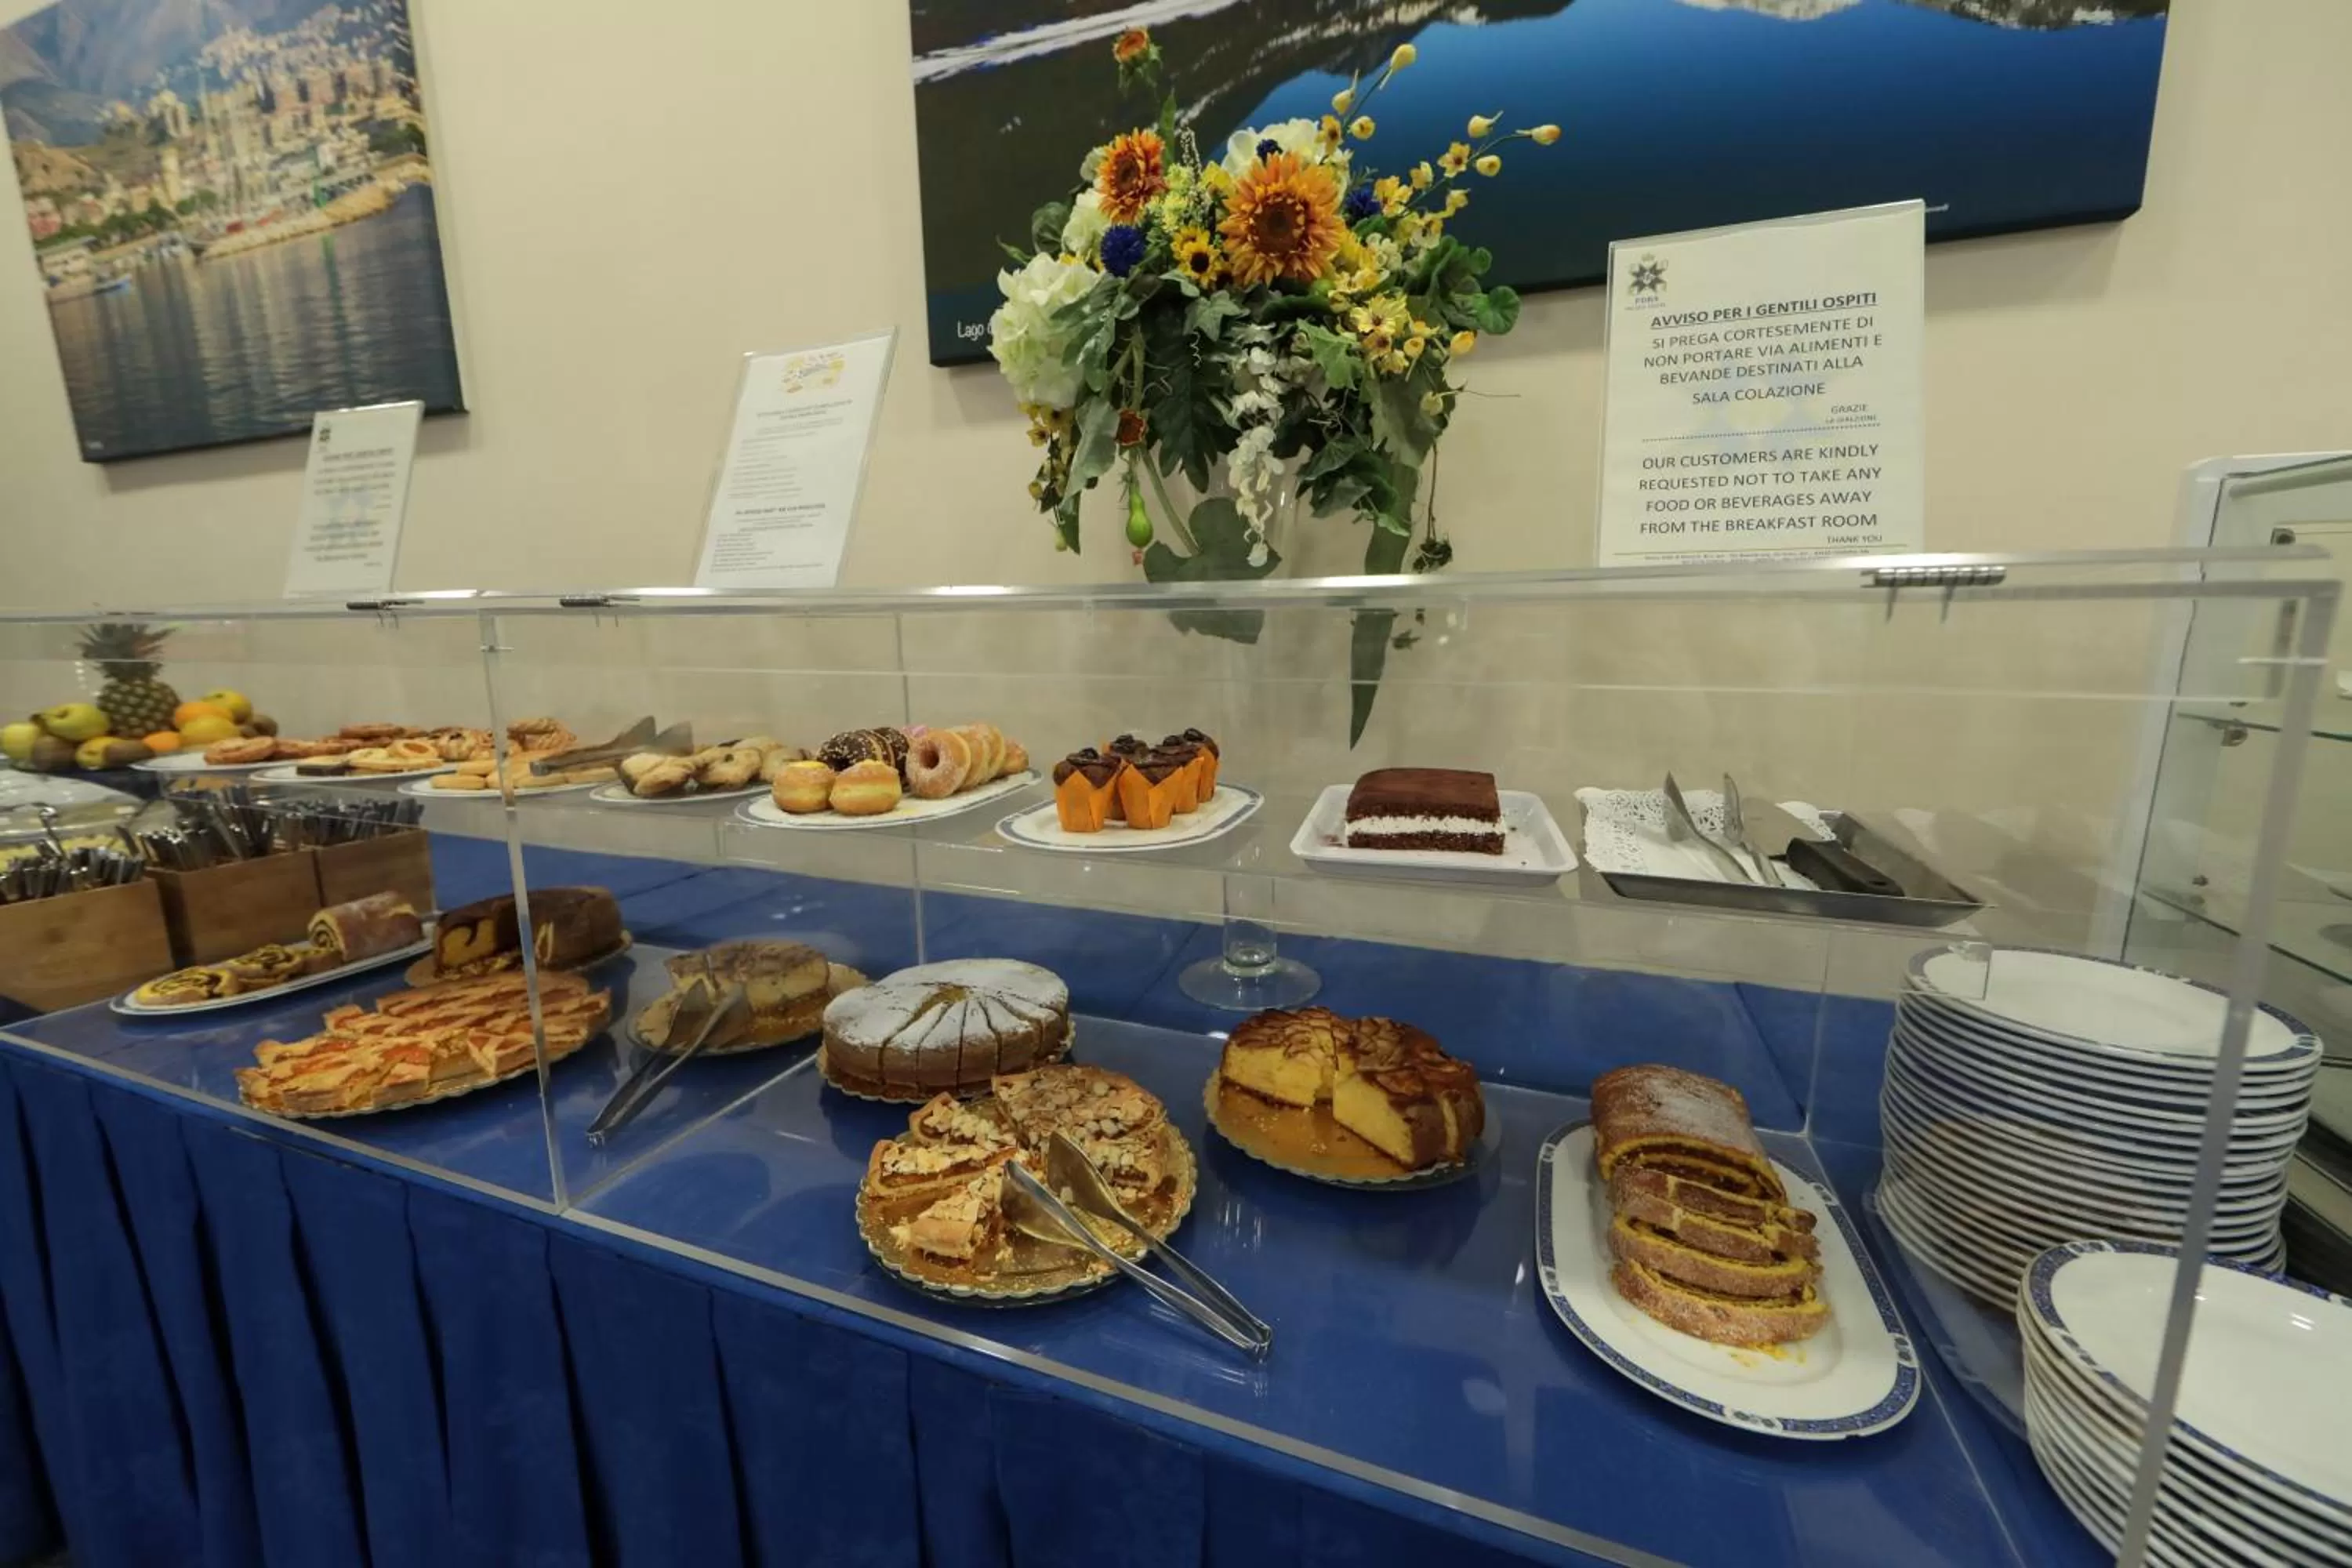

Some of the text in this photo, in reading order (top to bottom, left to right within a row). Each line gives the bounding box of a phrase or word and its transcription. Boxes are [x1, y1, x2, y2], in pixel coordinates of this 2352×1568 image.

[1650, 292, 1877, 328] AVVISO PER I GENTILI OSPITI
[957, 320, 984, 341] Lago
[1652, 316, 1874, 350] SI PREGA CORTESEMENTE DI
[1644, 334, 1882, 368] NON PORTARE VIA ALIMENTI E
[1660, 354, 1864, 385] BEVANDE DESTINATI ALLA
[1692, 383, 1827, 405] SALA COLAZIONE
[1831, 403, 1868, 415] GRAZIE
[1642, 444, 1879, 470] OUR CUSTOMERS ARE KINDLY
[1639, 467, 1882, 491] REQUESTED NOT TO TAKE ANY
[1646, 490, 1872, 512] FOOD OR BEVERAGES AWAY
[1640, 514, 1877, 534] FROM THE BREAKFAST ROOM
